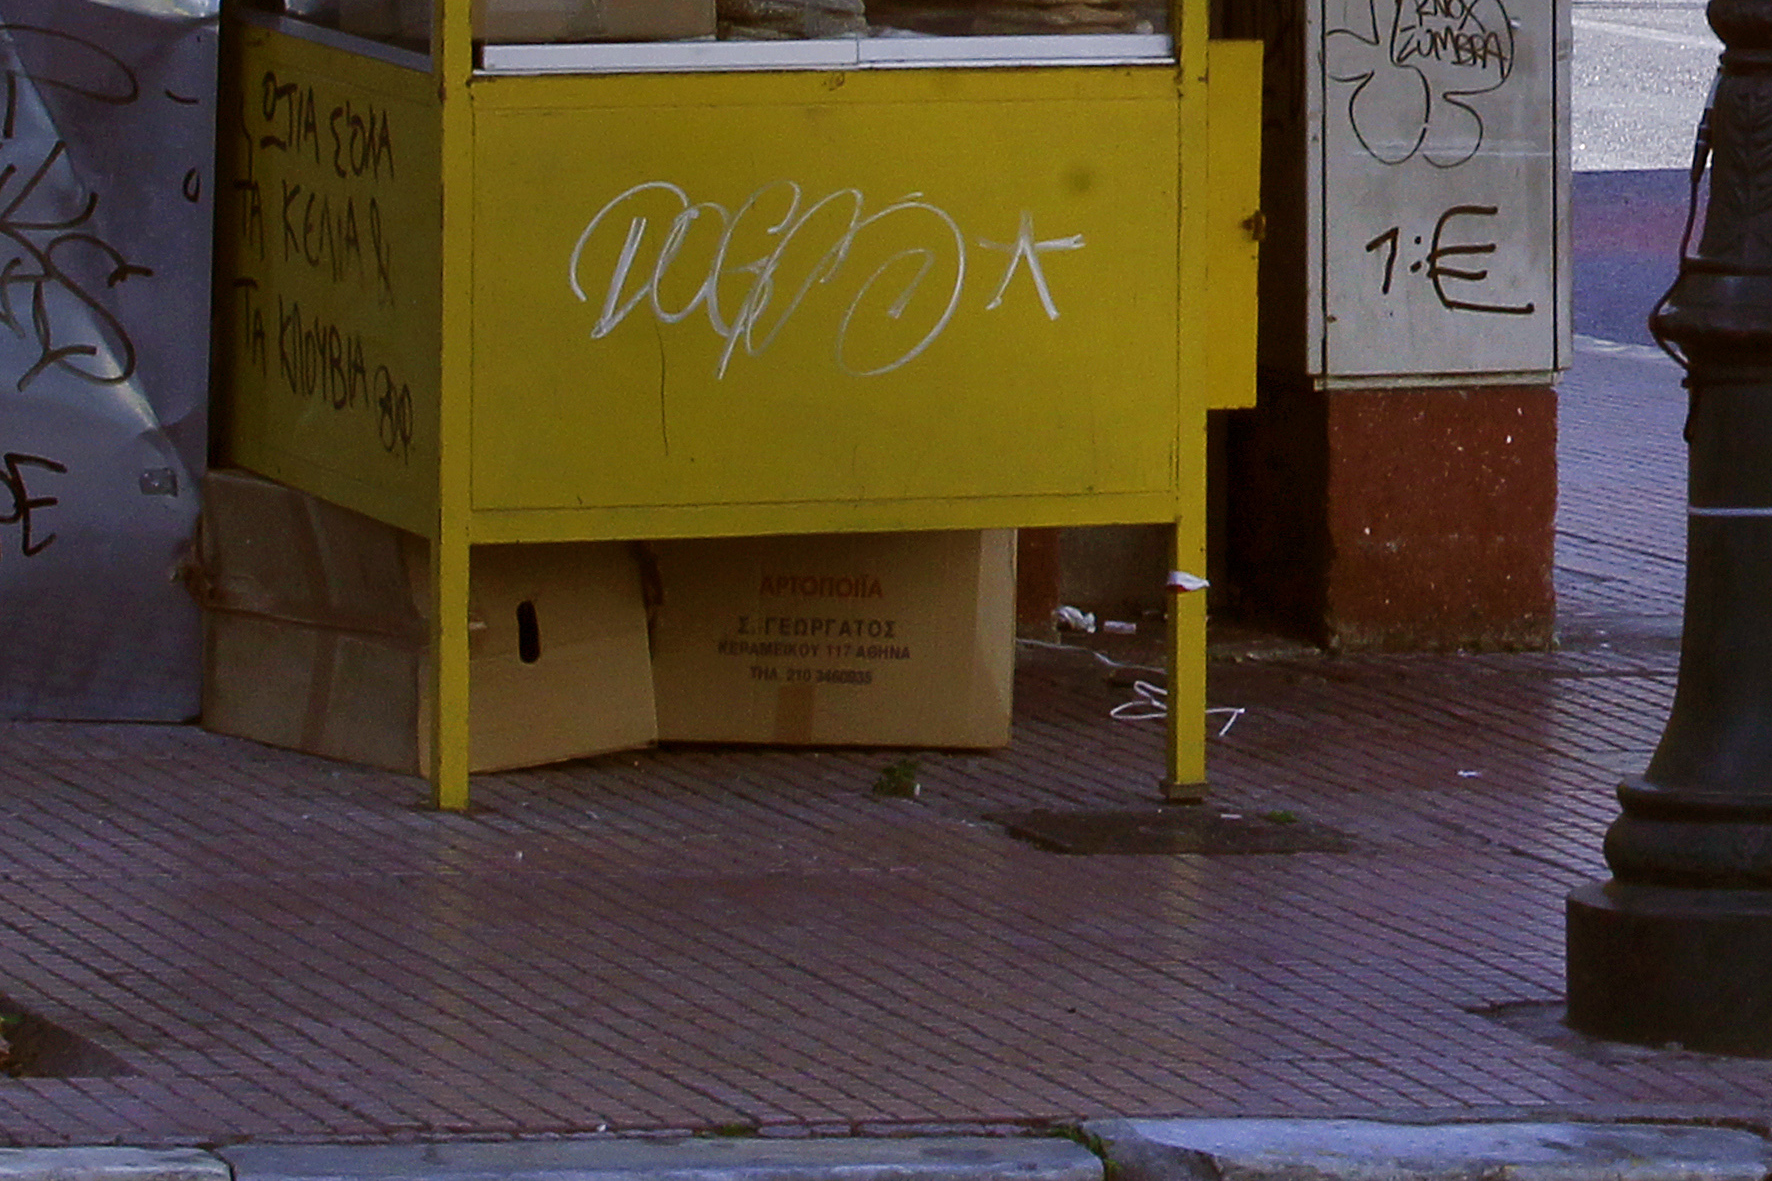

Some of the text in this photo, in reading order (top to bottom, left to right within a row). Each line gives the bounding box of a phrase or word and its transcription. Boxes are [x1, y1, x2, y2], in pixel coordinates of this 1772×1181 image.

[764, 616, 897, 639] ΓΕΩΡΓΑΤΟΣ
[855, 644, 911, 660] ΑΘΗΝΑ
[786, 669, 812, 683] 210
